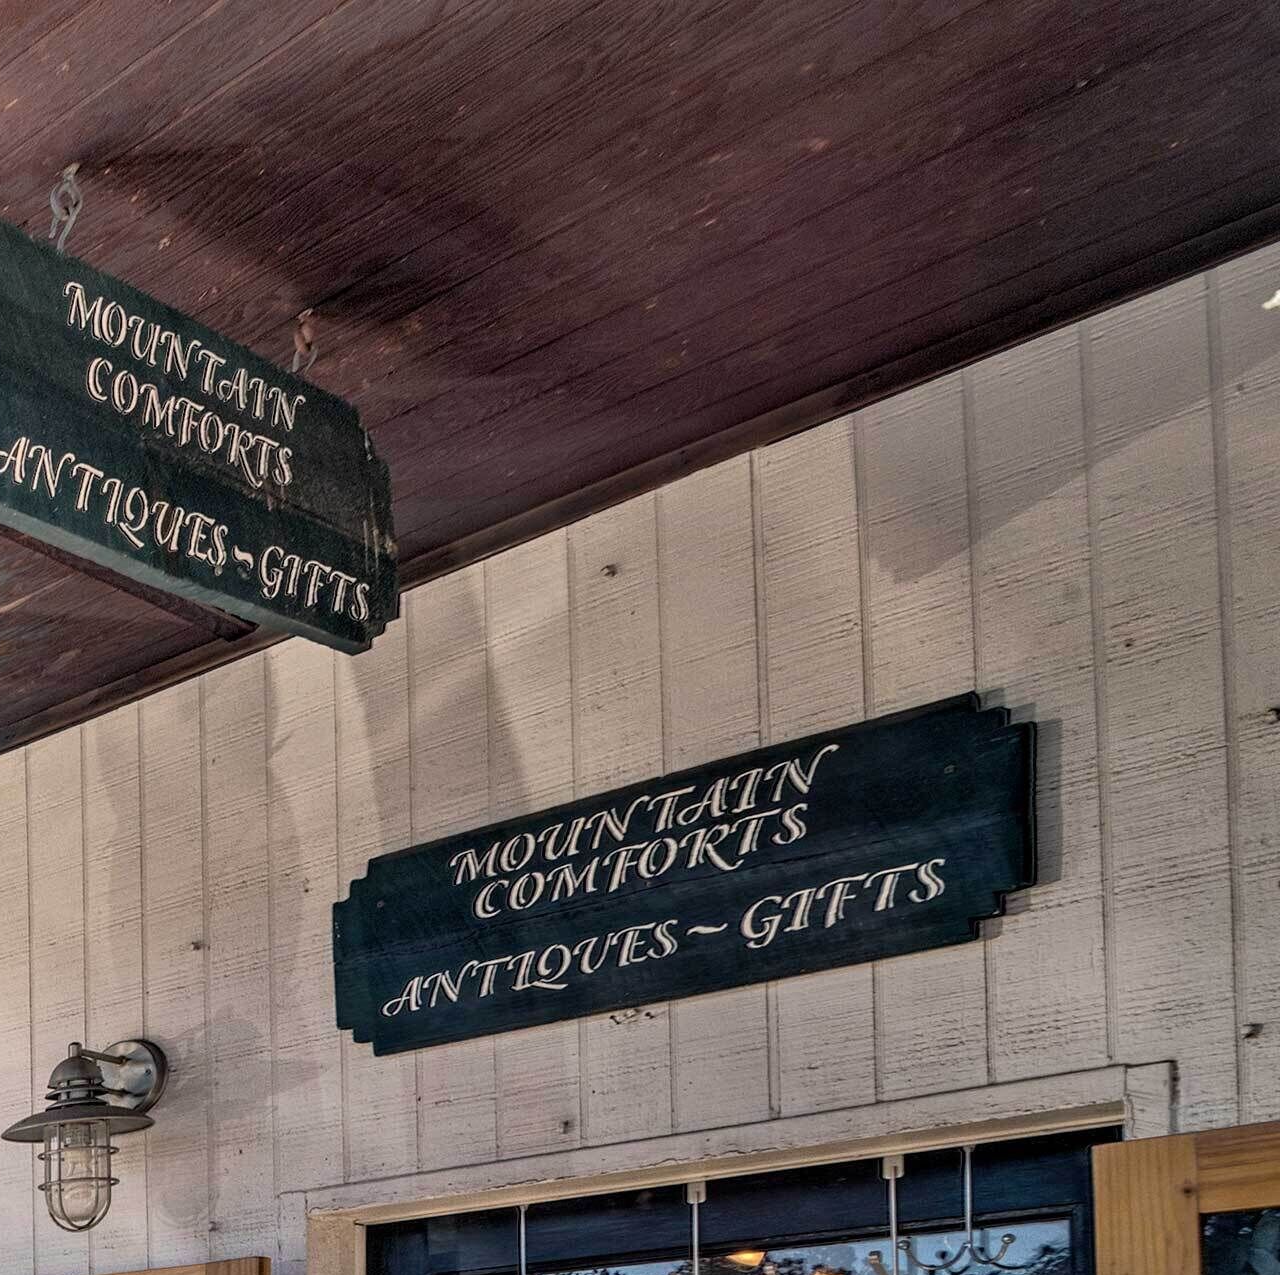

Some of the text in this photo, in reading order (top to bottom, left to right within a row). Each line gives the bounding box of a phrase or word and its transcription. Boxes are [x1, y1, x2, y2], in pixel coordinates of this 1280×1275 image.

[64, 281, 307, 432] MOUNTAIN
[87, 356, 294, 489] COMFORTS
[258, 544, 371, 623] GIFTS
[448, 743, 840, 886] MOUNTAIN
[472, 802, 809, 920] COMFORTS
[381, 919, 680, 1018] ANTIQUES
[741, 858, 947, 950] GIFTS
